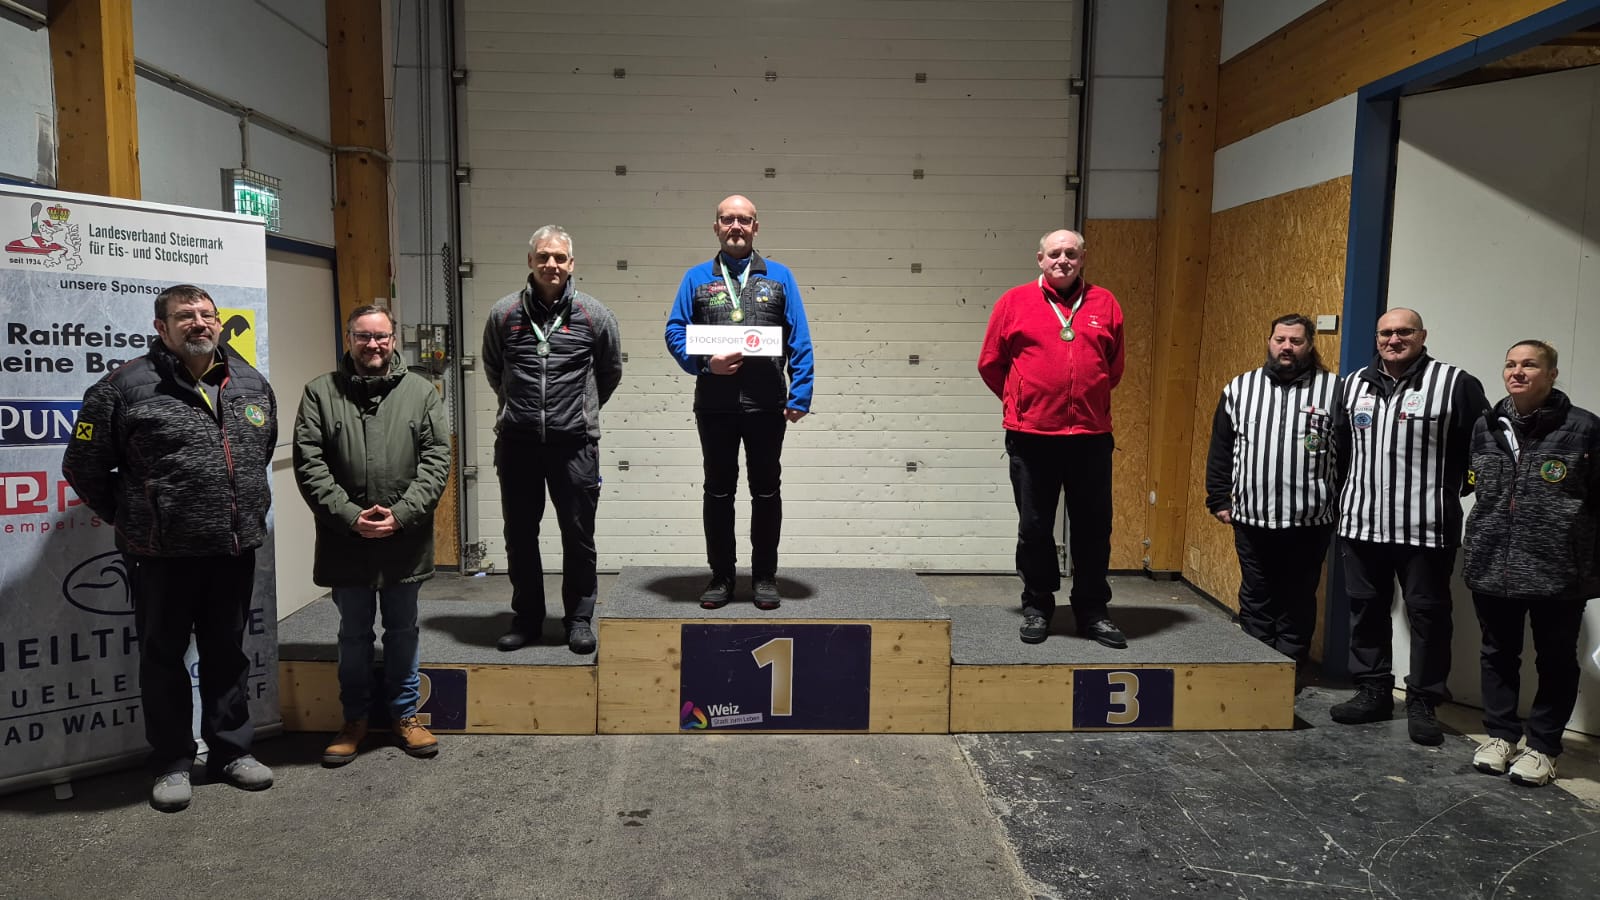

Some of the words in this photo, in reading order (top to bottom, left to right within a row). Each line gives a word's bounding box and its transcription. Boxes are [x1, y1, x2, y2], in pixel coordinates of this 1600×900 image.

[88, 223, 167, 245] Landesverband
[169, 232, 224, 250] Steiermark
[9, 257, 24, 265] seit
[88, 240, 105, 256] für
[108, 242, 129, 258] Eis-
[133, 246, 152, 260] und
[155, 247, 209, 266] Stocksport
[60, 280, 107, 292] unsere
[688, 336, 744, 345] STOCKSPORT
[761, 337, 780, 345] YOU
[0, 349, 74, 373] eine
[0, 627, 141, 673] EILTH
[11, 671, 141, 709] UELLE
[751, 637, 794, 717] 1
[706, 702, 740, 717] Weiz
[1106, 671, 1140, 725] 3
